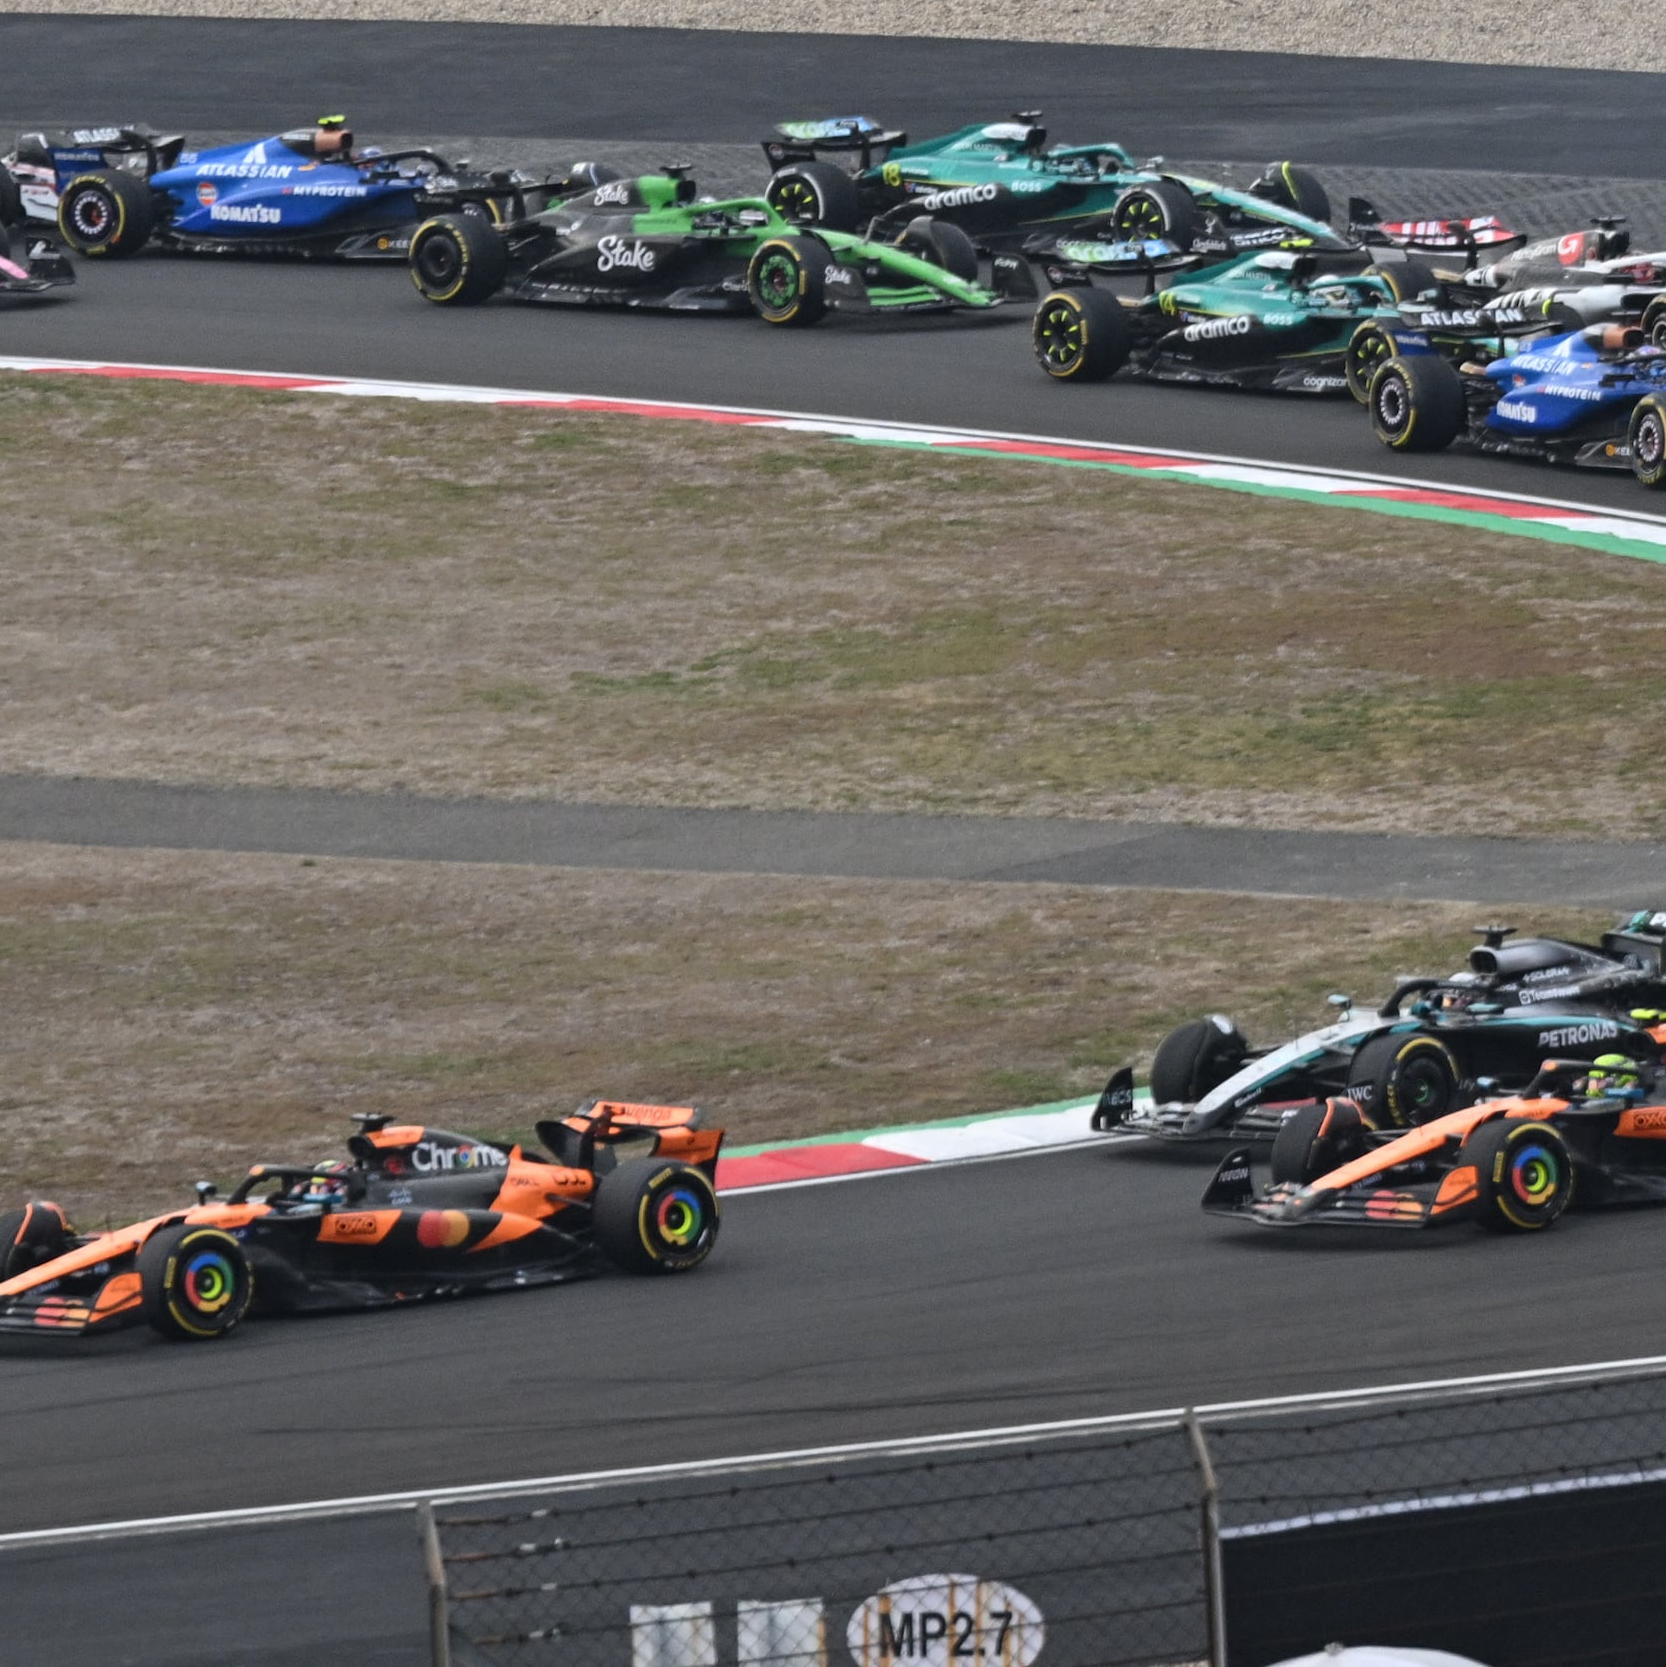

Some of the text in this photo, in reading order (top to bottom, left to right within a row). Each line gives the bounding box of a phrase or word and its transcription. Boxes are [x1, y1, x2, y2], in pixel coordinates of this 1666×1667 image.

[196, 163, 294, 179] ATLASSIAN
[293, 185, 368, 198] MYPROTEIN
[594, 185, 629, 206] Stake
[924, 183, 998, 211] aramco
[1011, 181, 1043, 193] BOSS
[210, 202, 282, 224] KOMATSU
[597, 234, 655, 272] Stake
[824, 265, 852, 284] Stake
[1184, 316, 1250, 342] aramco
[1262, 314, 1294, 326] BOSS
[1510, 354, 1578, 376] ATLASSIAN
[1303, 375, 1350, 390] cognizan
[1544, 385, 1602, 402] MYPROTEIN
[1538, 1021, 1619, 1048] PETRONAS
[1347, 1084, 1373, 1102] IWC
[879, 1611, 1014, 1659] MP2.7
